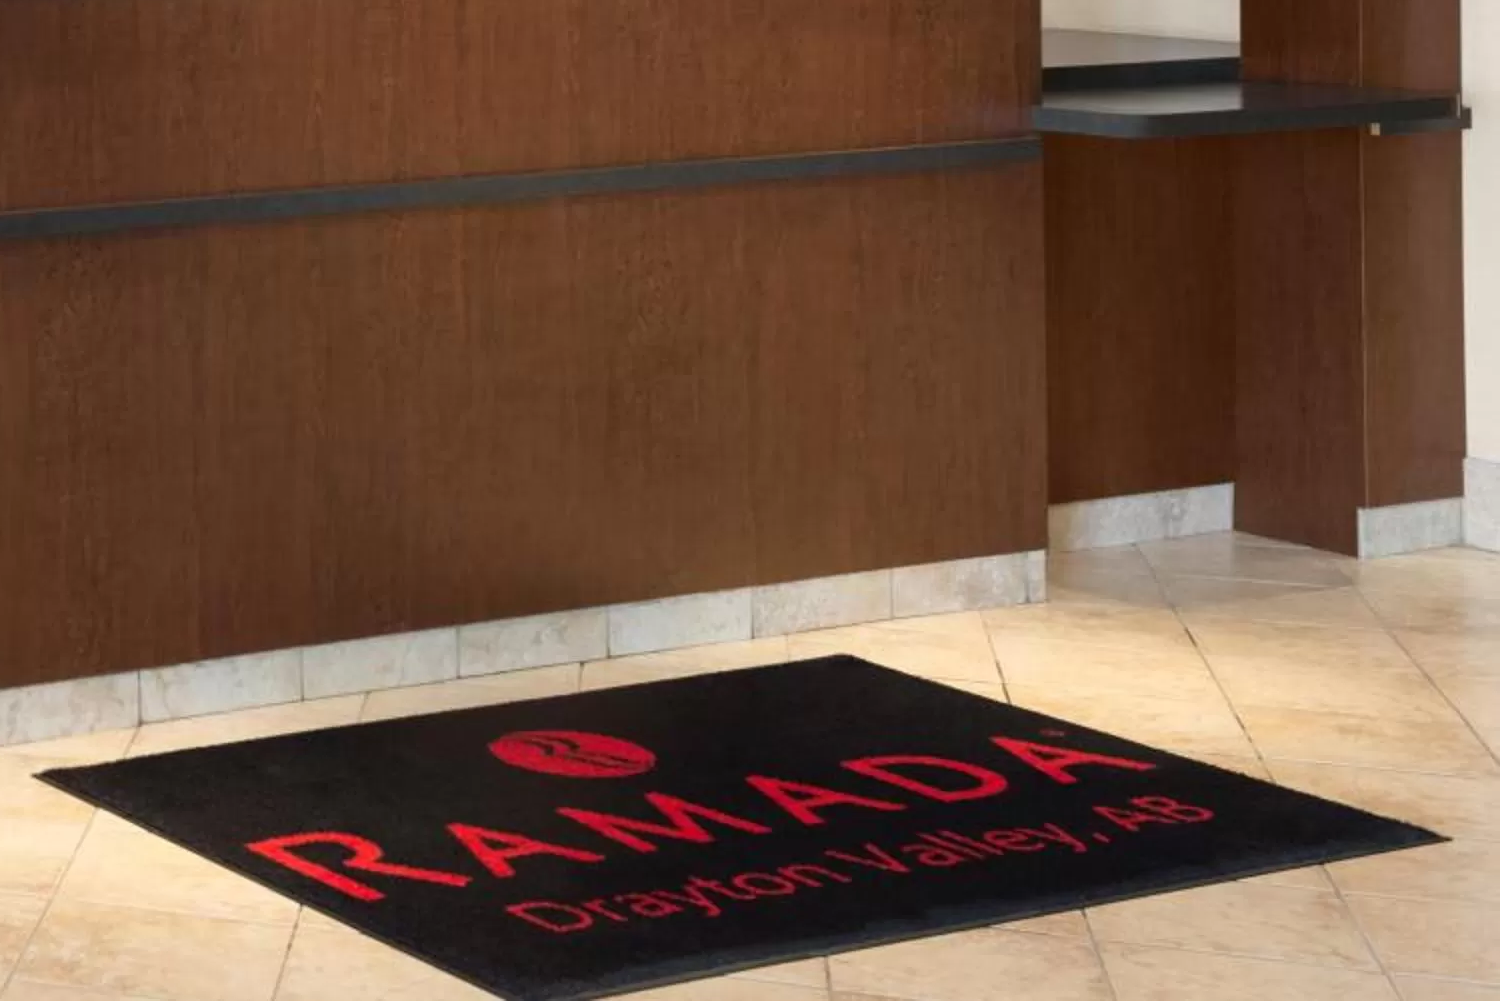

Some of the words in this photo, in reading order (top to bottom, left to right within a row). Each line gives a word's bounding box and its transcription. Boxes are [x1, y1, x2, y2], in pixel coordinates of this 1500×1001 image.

[247, 737, 1156, 901] RAMADA
[506, 856, 852, 934] Drayton
[825, 814, 1112, 874] Valley,
[1093, 795, 1215, 833] AB
